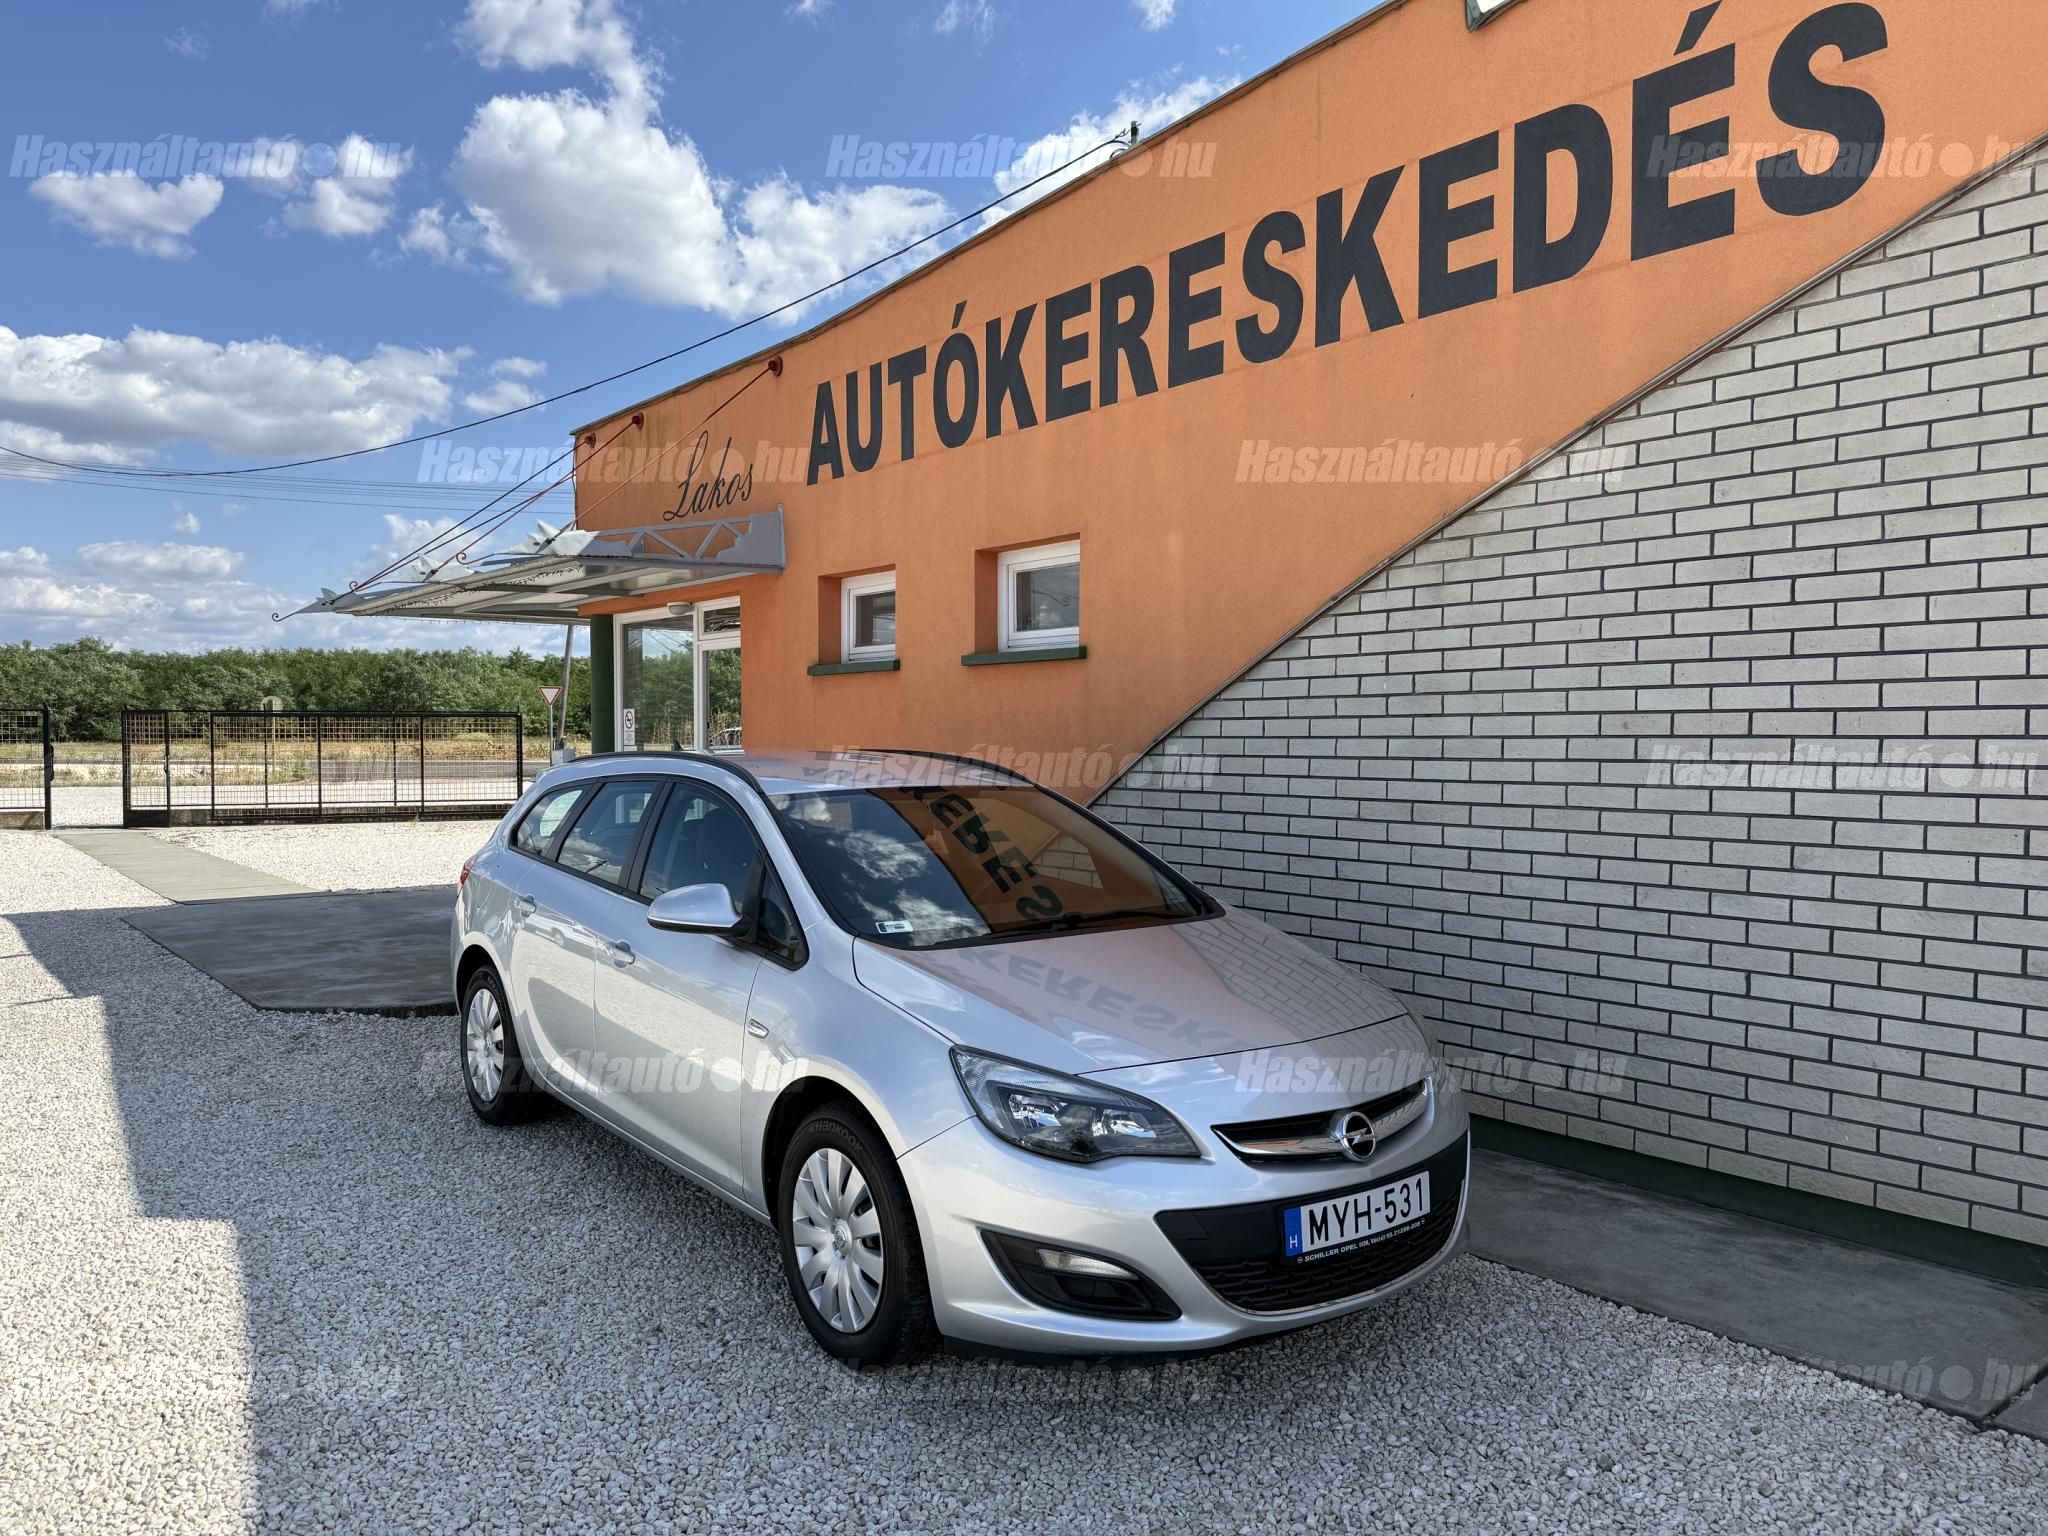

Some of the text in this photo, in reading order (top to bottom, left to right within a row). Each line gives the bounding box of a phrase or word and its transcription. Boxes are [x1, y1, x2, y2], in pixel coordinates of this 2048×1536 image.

[806, 1, 1889, 486] AUTÓKERESKEDÉS
[663, 430, 753, 521] Lakos
[1289, 1177, 1423, 1249] H MYH-531
[1304, 1248, 1339, 1262] SCHILLER
[1340, 1243, 1359, 1254] OPEL
